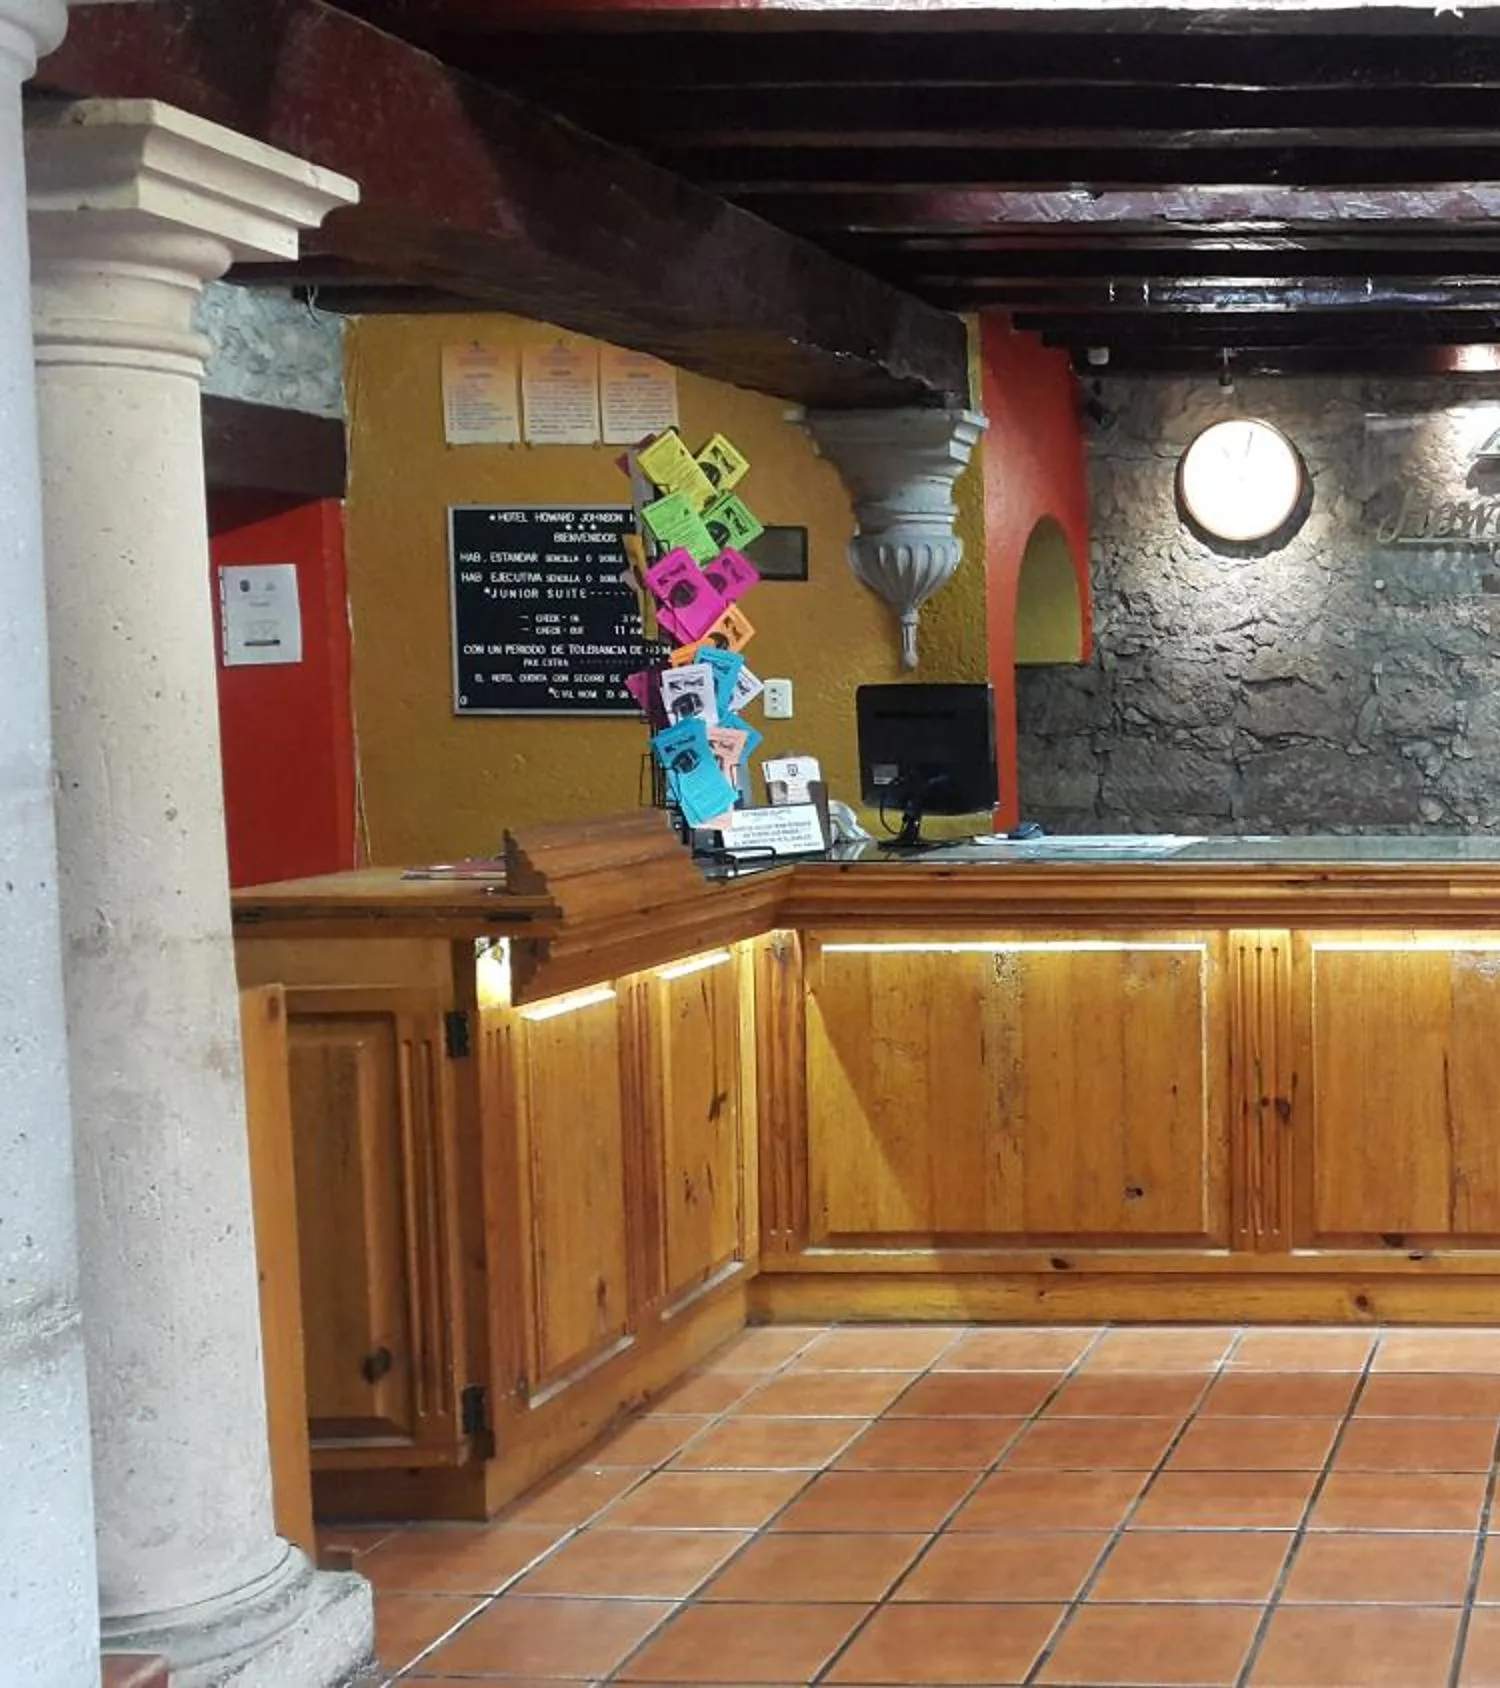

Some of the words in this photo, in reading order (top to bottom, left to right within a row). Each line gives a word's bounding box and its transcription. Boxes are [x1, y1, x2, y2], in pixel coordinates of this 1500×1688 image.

[498, 512, 528, 523] HOTEL
[535, 512, 575, 523] HOWARD
[580, 512, 623, 523] JOHNSON
[553, 533, 617, 543] BIENVENIDOS
[490, 552, 539, 563] ESTANDAR
[490, 572, 543, 584] EJECUTIVA
[491, 588, 540, 599] JUNIOR
[547, 587, 588, 599] SUITE
[463, 643, 485, 655] CON
[487, 643, 503, 655] UN
[505, 643, 547, 655] PERIODO
[551, 643, 566, 655] DE
[568, 643, 628, 656] TOLERANCIA
